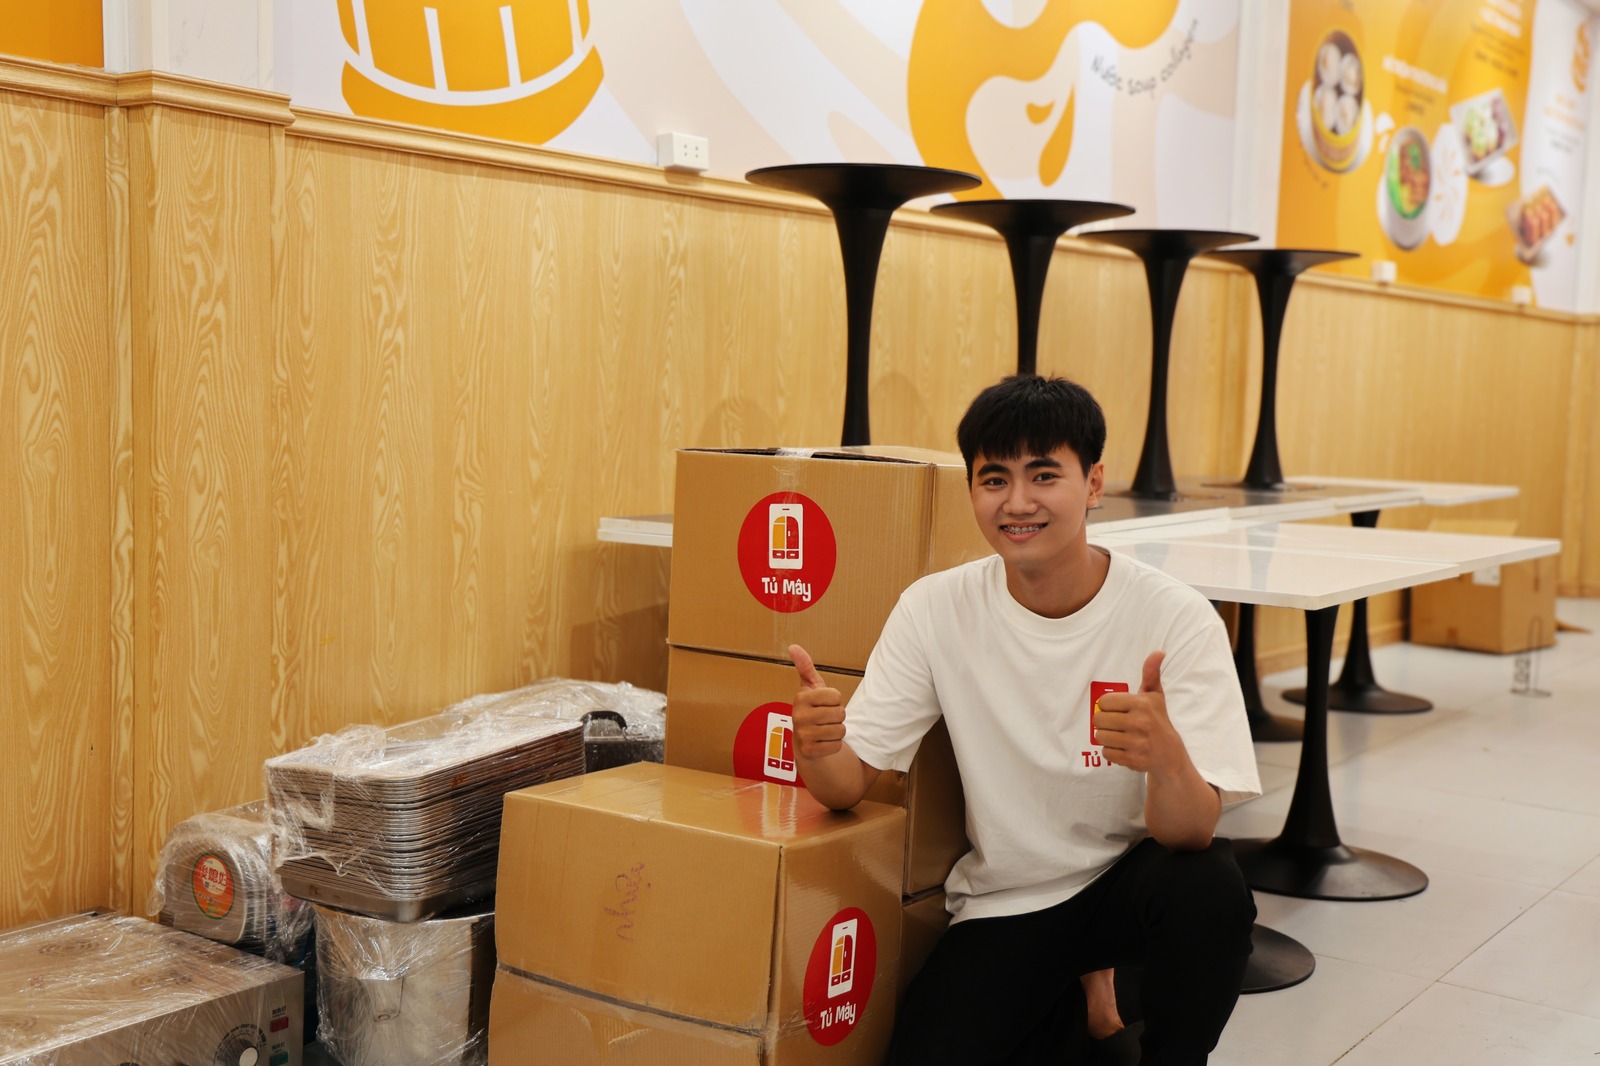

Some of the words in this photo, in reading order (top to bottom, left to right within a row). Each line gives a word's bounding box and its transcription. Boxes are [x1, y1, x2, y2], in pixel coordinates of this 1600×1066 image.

[1127, 77, 1157, 101] soup
[761, 576, 779, 594] Tủ
[782, 578, 812, 602] Mây
[1081, 750, 1102, 768] Tủ
[820, 1007, 833, 1030] Tủ
[835, 1001, 857, 1026] Mây
